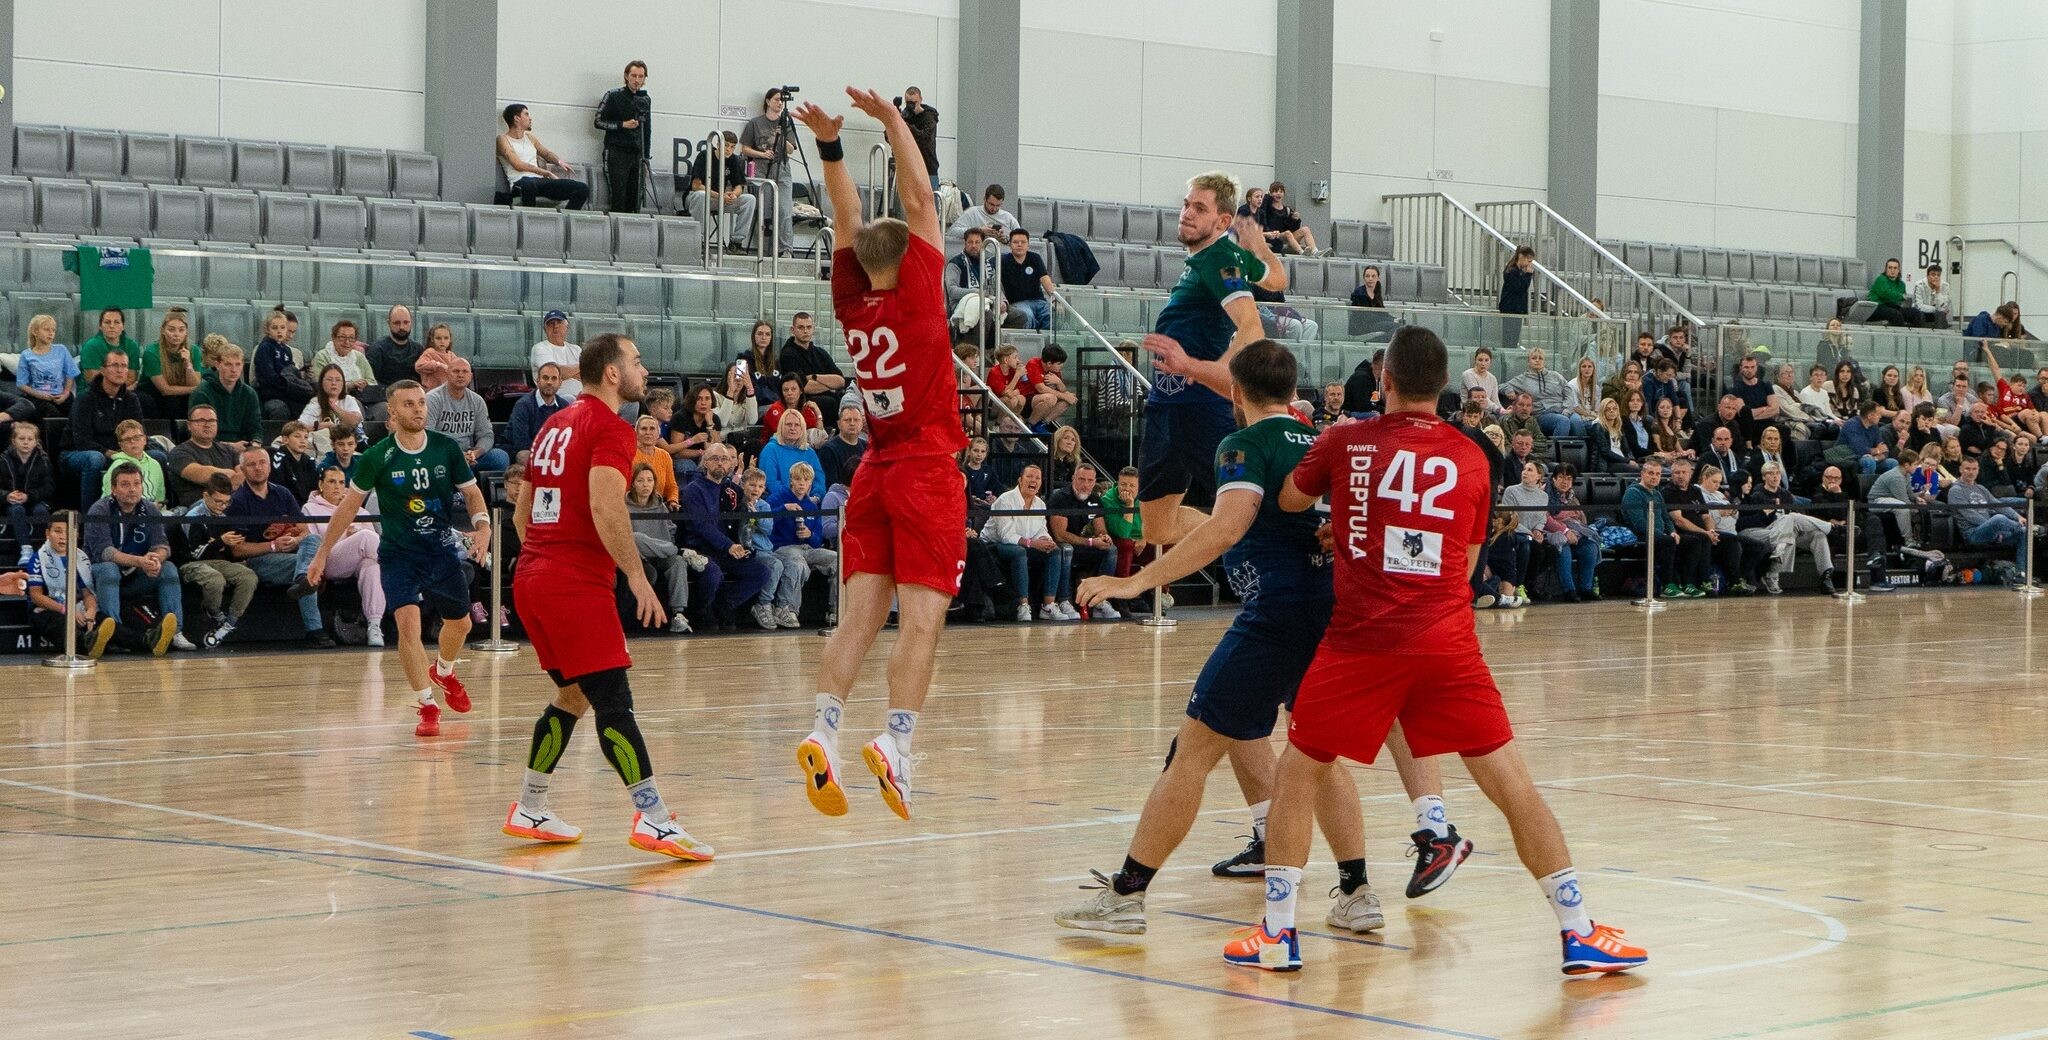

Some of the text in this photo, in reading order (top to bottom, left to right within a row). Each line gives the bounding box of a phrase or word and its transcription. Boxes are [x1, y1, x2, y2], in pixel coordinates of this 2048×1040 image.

[1918, 238, 1941, 269] B4
[848, 326, 906, 379] 22
[442, 422, 472, 434] DUNK
[534, 426, 572, 475] 43
[1347, 444, 1378, 452] PAWEŁ
[412, 467, 429, 490] 33
[1377, 449, 1458, 520] 42
[1349, 456, 1372, 560] DEPTUŁA
[1386, 556, 1438, 569] TROFEUM
[1890, 575, 1910, 585] SEKTOR
[1911, 574, 1919, 584] A4
[16, 634, 32, 648] A1
